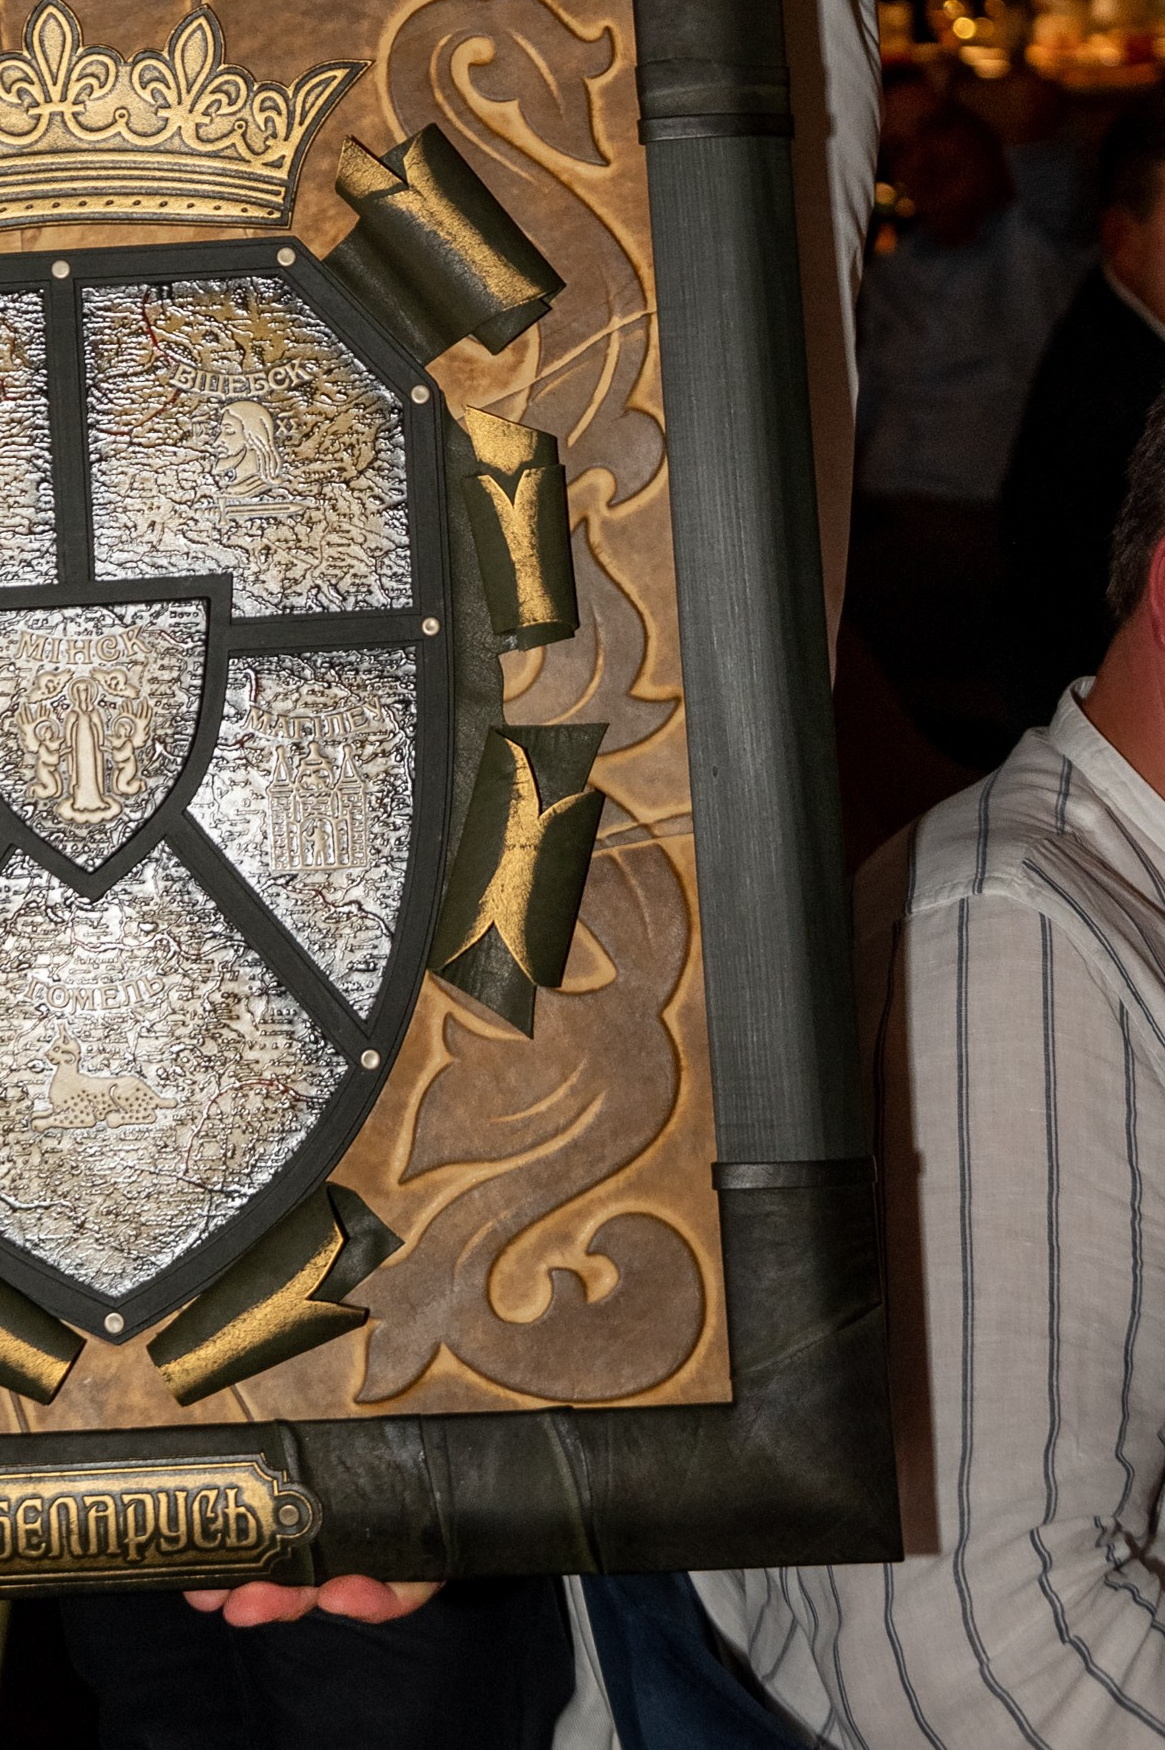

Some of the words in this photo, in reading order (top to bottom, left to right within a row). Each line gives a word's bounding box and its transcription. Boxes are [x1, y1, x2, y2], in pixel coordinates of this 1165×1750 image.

[169, 357, 314, 399] ВІЦЕБСК
[14, 625, 152, 664] МІНСК
[24, 974, 166, 1016] ГОМЕЛЬ
